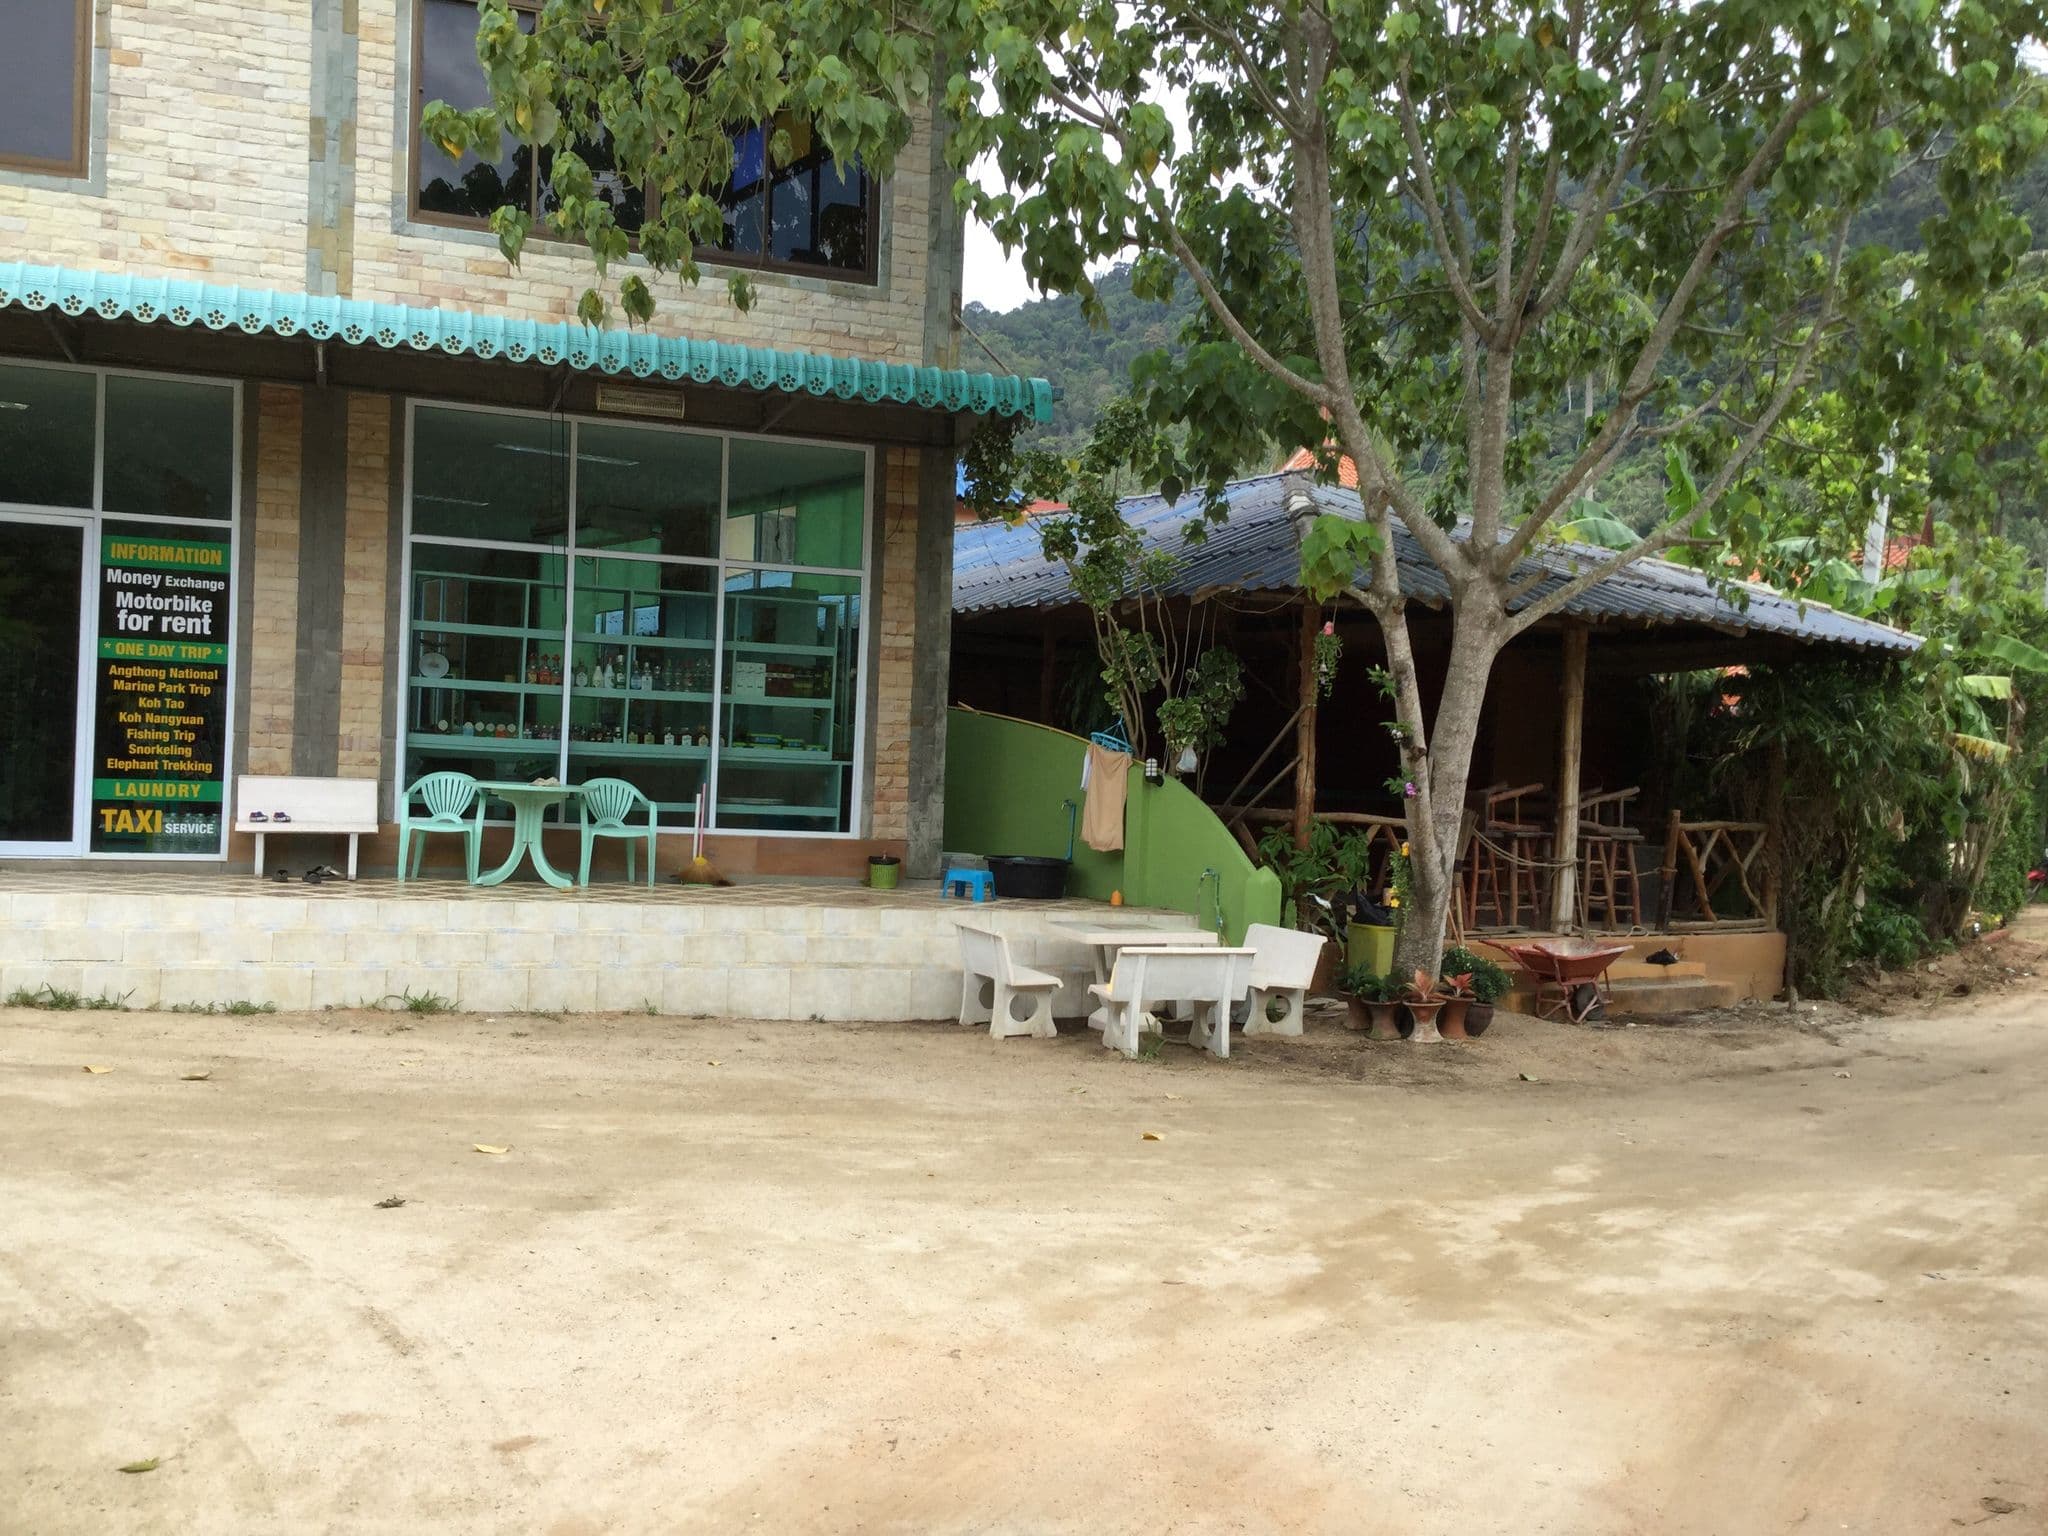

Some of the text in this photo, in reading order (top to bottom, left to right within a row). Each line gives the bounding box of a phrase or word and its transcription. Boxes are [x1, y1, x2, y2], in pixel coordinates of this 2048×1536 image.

[111, 543, 223, 565] INFORMATION
[107, 568, 225, 592] Money Exchange
[116, 591, 213, 613] Motorbike
[117, 609, 212, 635] for rent
[115, 642, 211, 659] ONE DAY TRIP
[109, 665, 218, 680] Angthong National
[113, 680, 211, 696] Marine Park Trip
[138, 697, 185, 709] Koh Tao
[119, 712, 204, 726] Koh Nangyuan
[127, 728, 195, 742] Fishing Trip
[128, 744, 192, 757] Snorkeling
[107, 758, 213, 773] Elephant Trekking
[114, 782, 202, 798] LAUNDRY
[100, 809, 214, 834] TAXI SERVICE
